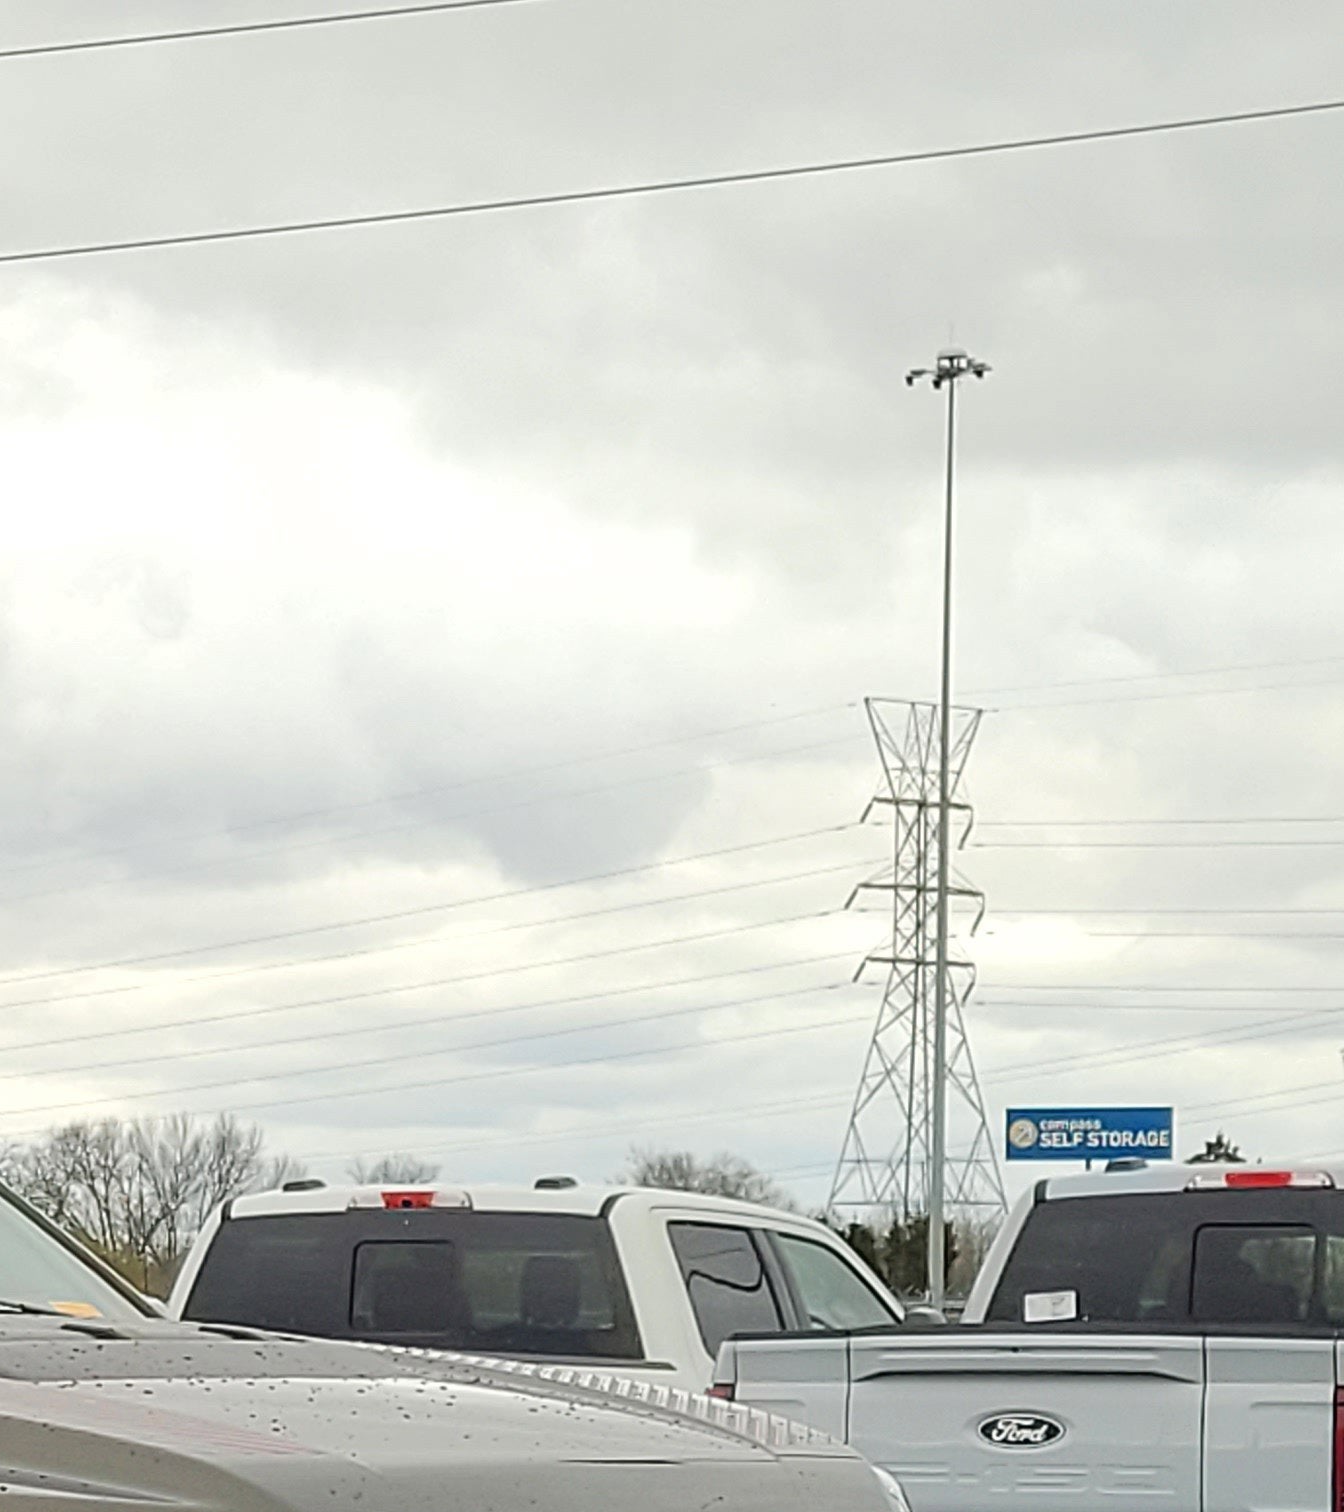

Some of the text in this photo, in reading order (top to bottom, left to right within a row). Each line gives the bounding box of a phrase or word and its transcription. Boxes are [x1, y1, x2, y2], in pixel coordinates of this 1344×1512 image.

[1039, 1130, 1170, 1148] SELF STORAGE
[991, 1418, 1049, 1442] Ford
